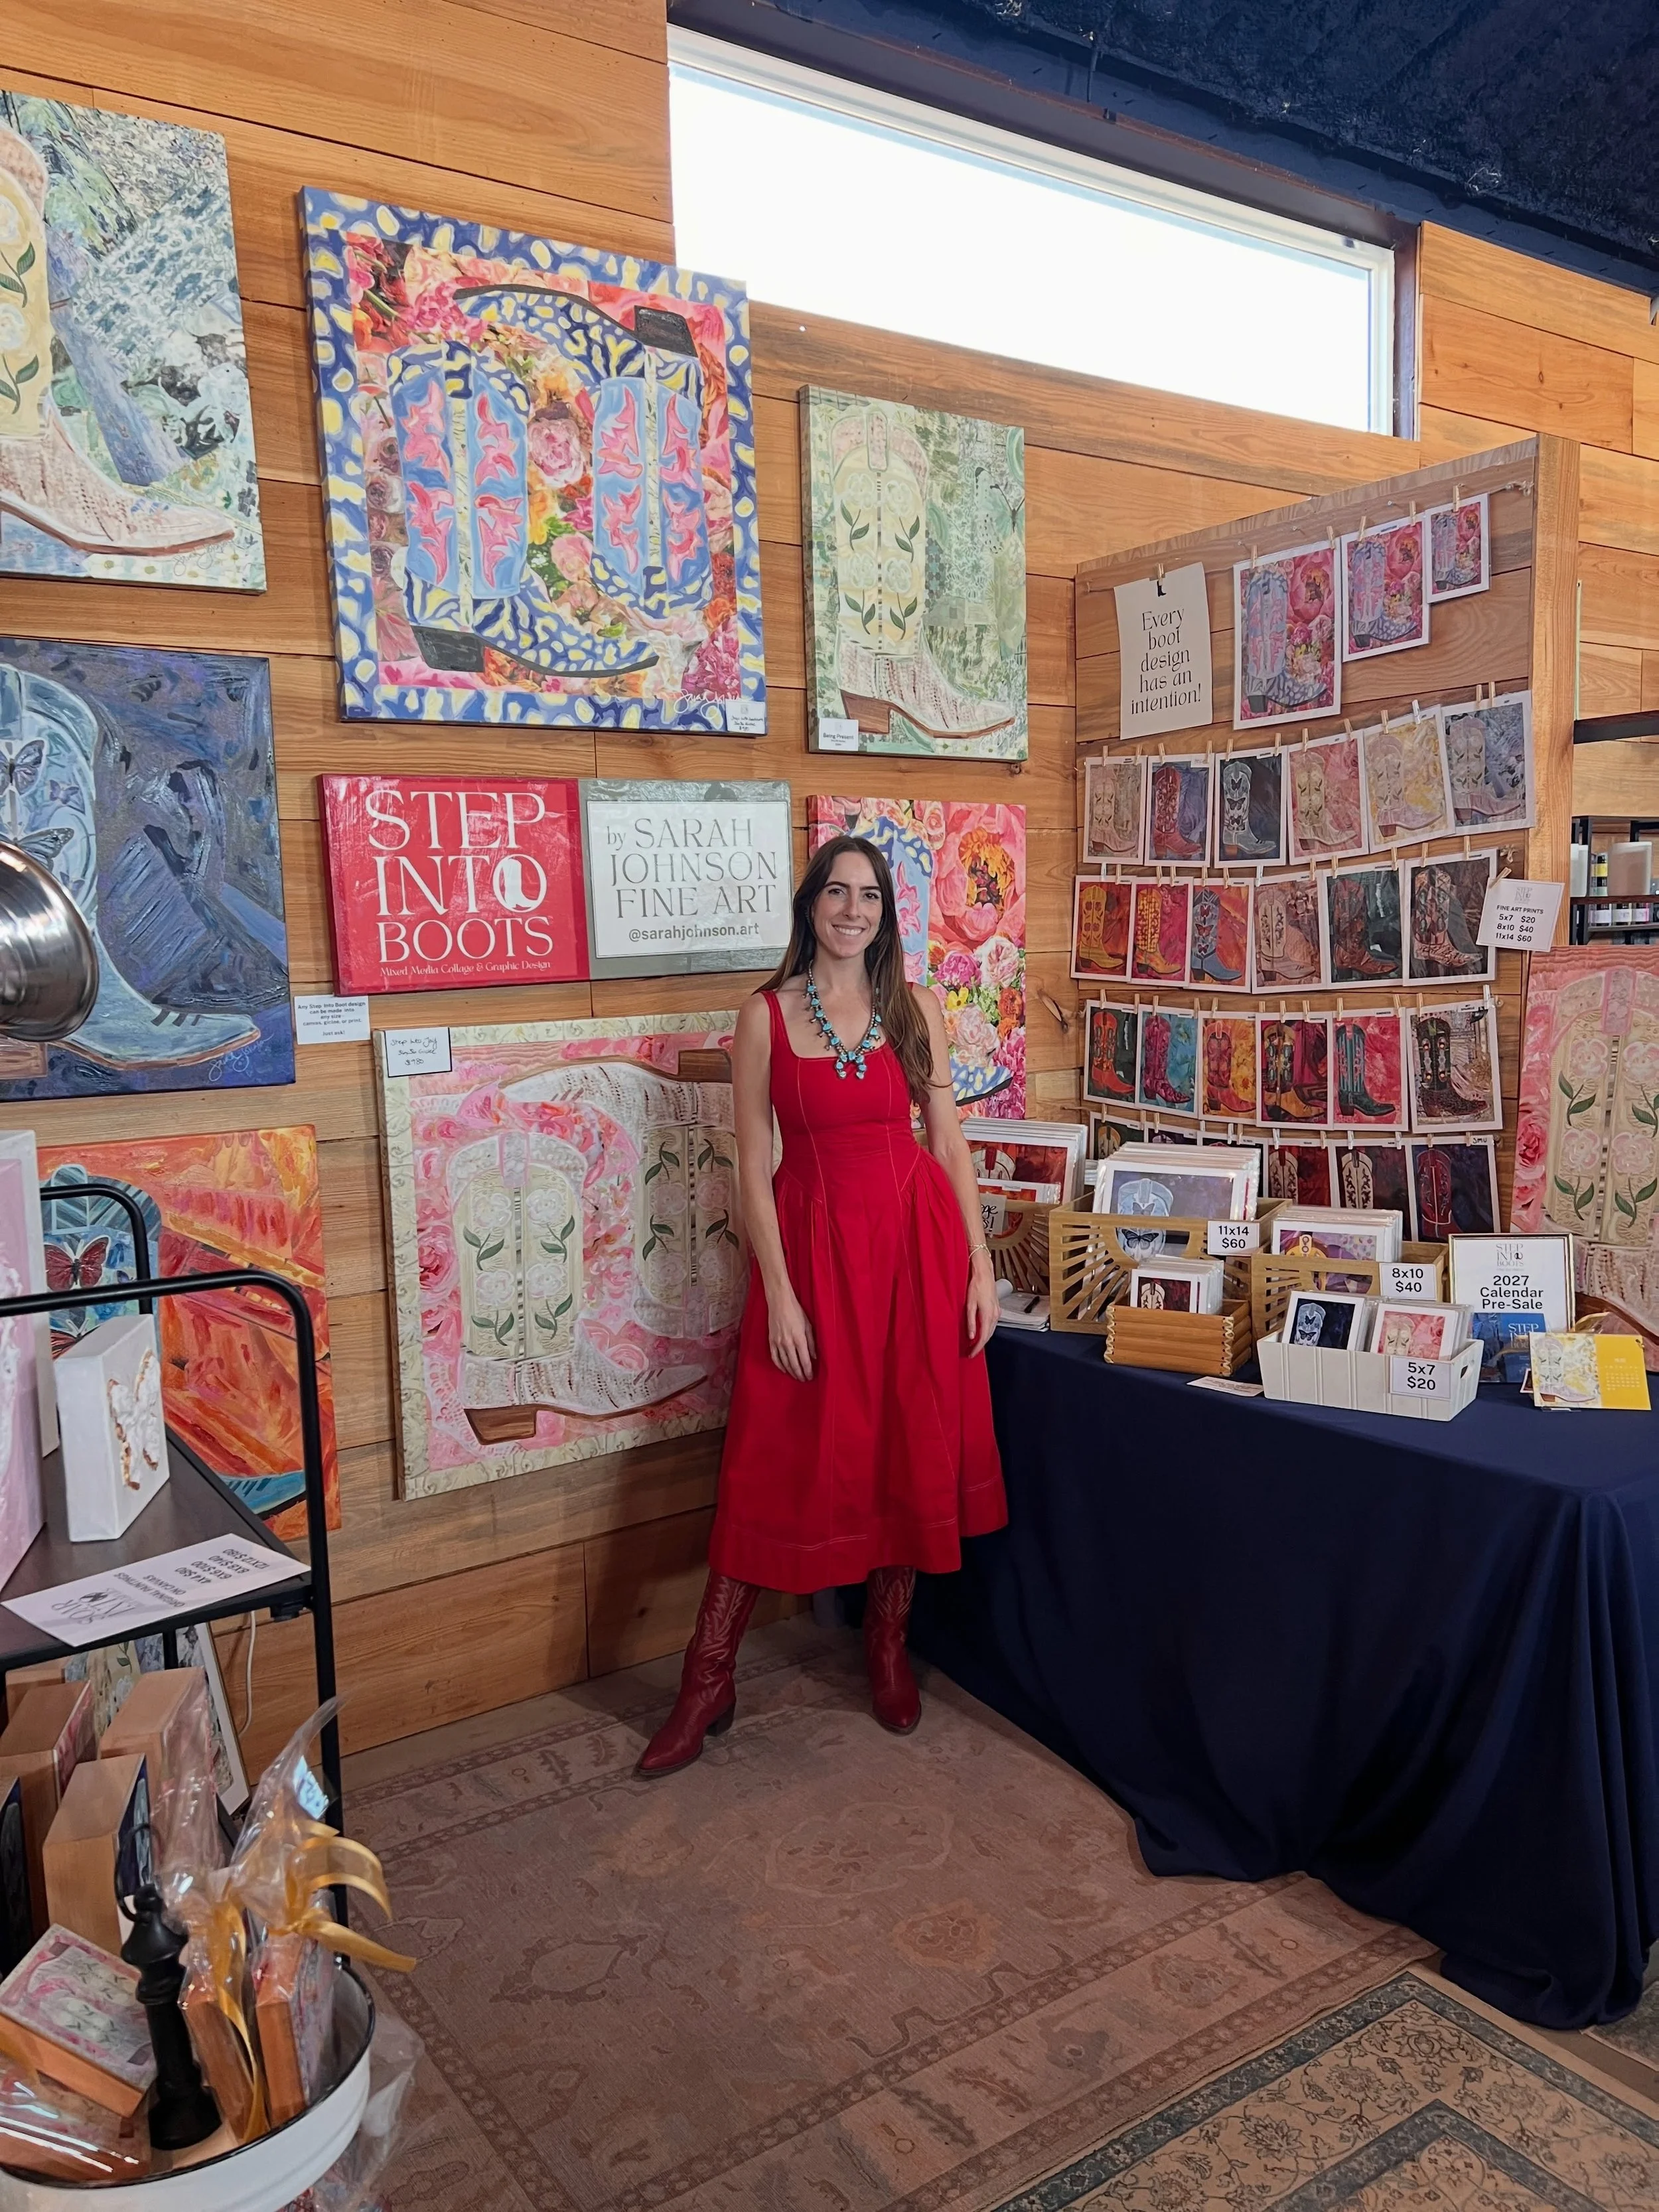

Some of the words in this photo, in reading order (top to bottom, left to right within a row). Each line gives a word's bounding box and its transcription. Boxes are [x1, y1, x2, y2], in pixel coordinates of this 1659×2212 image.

[1142, 607, 1185, 632] Every
[1149, 628, 1181, 650] boot
[1141, 649, 1190, 673] design
[1139, 674, 1167, 694] has
[1173, 670, 1192, 686] an
[1131, 683, 1201, 715] intention!
[365, 789, 545, 850] STEP
[607, 826, 626, 850] by
[634, 818, 753, 849] SARAH
[611, 851, 778, 886] JOHNSON
[372, 853, 547, 916] INTO
[616, 887, 699, 919] FINE
[713, 885, 776, 914] ART
[1520, 915, 1536, 924] $20
[628, 922, 759, 942] @sarahjohnson.art
[1519, 924, 1534, 933] $40
[376, 916, 553, 962] BOOTS
[380, 966, 408, 976] Mixed
[411, 964, 439, 976] Media
[441, 963, 474, 975] Collage
[485, 962, 518, 973] Graphic
[522, 960, 550, 971] Design
[1218, 1225, 1249, 1236] 11x14
[1222, 1237, 1246, 1249] $60
[1496, 1243, 1524, 1252] STEP
[1392, 1268, 1423, 1279] 8x10
[1493, 1275, 1530, 1286] 2027
[1396, 1280, 1422, 1293] $40
[1480, 1287, 1544, 1297] Calendar
[1482, 1299, 1543, 1309] Pre-Sale
[1508, 1323, 1539, 1333] STEP
[1407, 1362, 1435, 1375] 5x7
[1407, 1375, 1436, 1390] $20
[190, 1561, 216, 1572] $100
[208, 1555, 233, 1566] $140
[241, 1556, 270, 1569] 12X12
[113, 1572, 153, 1592] PAINTINGS
[143, 1574, 174, 1589] CANVAS
[190, 1575, 212, 1584] 4X4
[209, 1570, 232, 1580] 6X6
[149, 1589, 185, 1607] ORIGINAL
